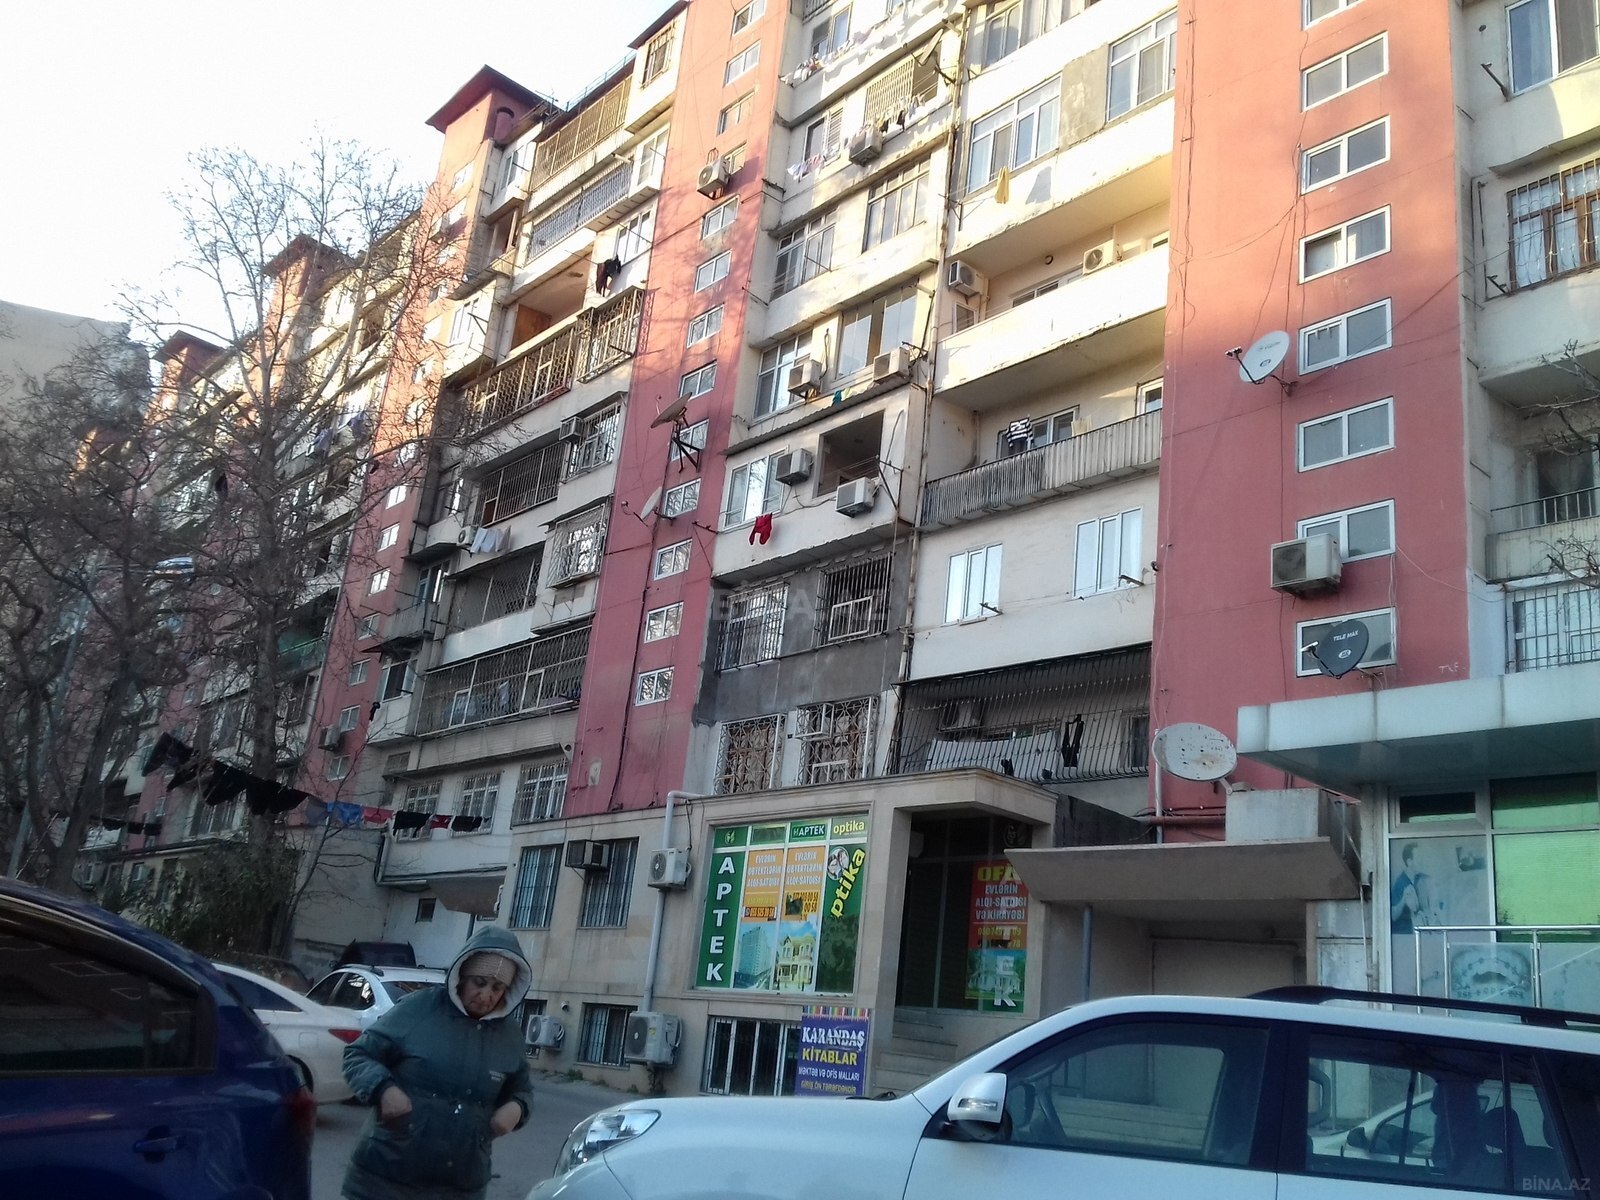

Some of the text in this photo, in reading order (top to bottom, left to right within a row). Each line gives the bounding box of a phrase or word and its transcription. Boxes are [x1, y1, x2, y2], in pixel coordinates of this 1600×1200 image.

[1333, 633, 1346, 641] TELE
[833, 820, 865, 836] optika
[985, 882, 1018, 894] EVLƏRİN
[706, 856, 735, 981] APTEK
[802, 1026, 865, 1051] KARANDAŞ
[802, 1046, 858, 1066] KİTABLAR
[798, 1066, 860, 1082] MƏKTƏB VƏ OFİS MALLARI
